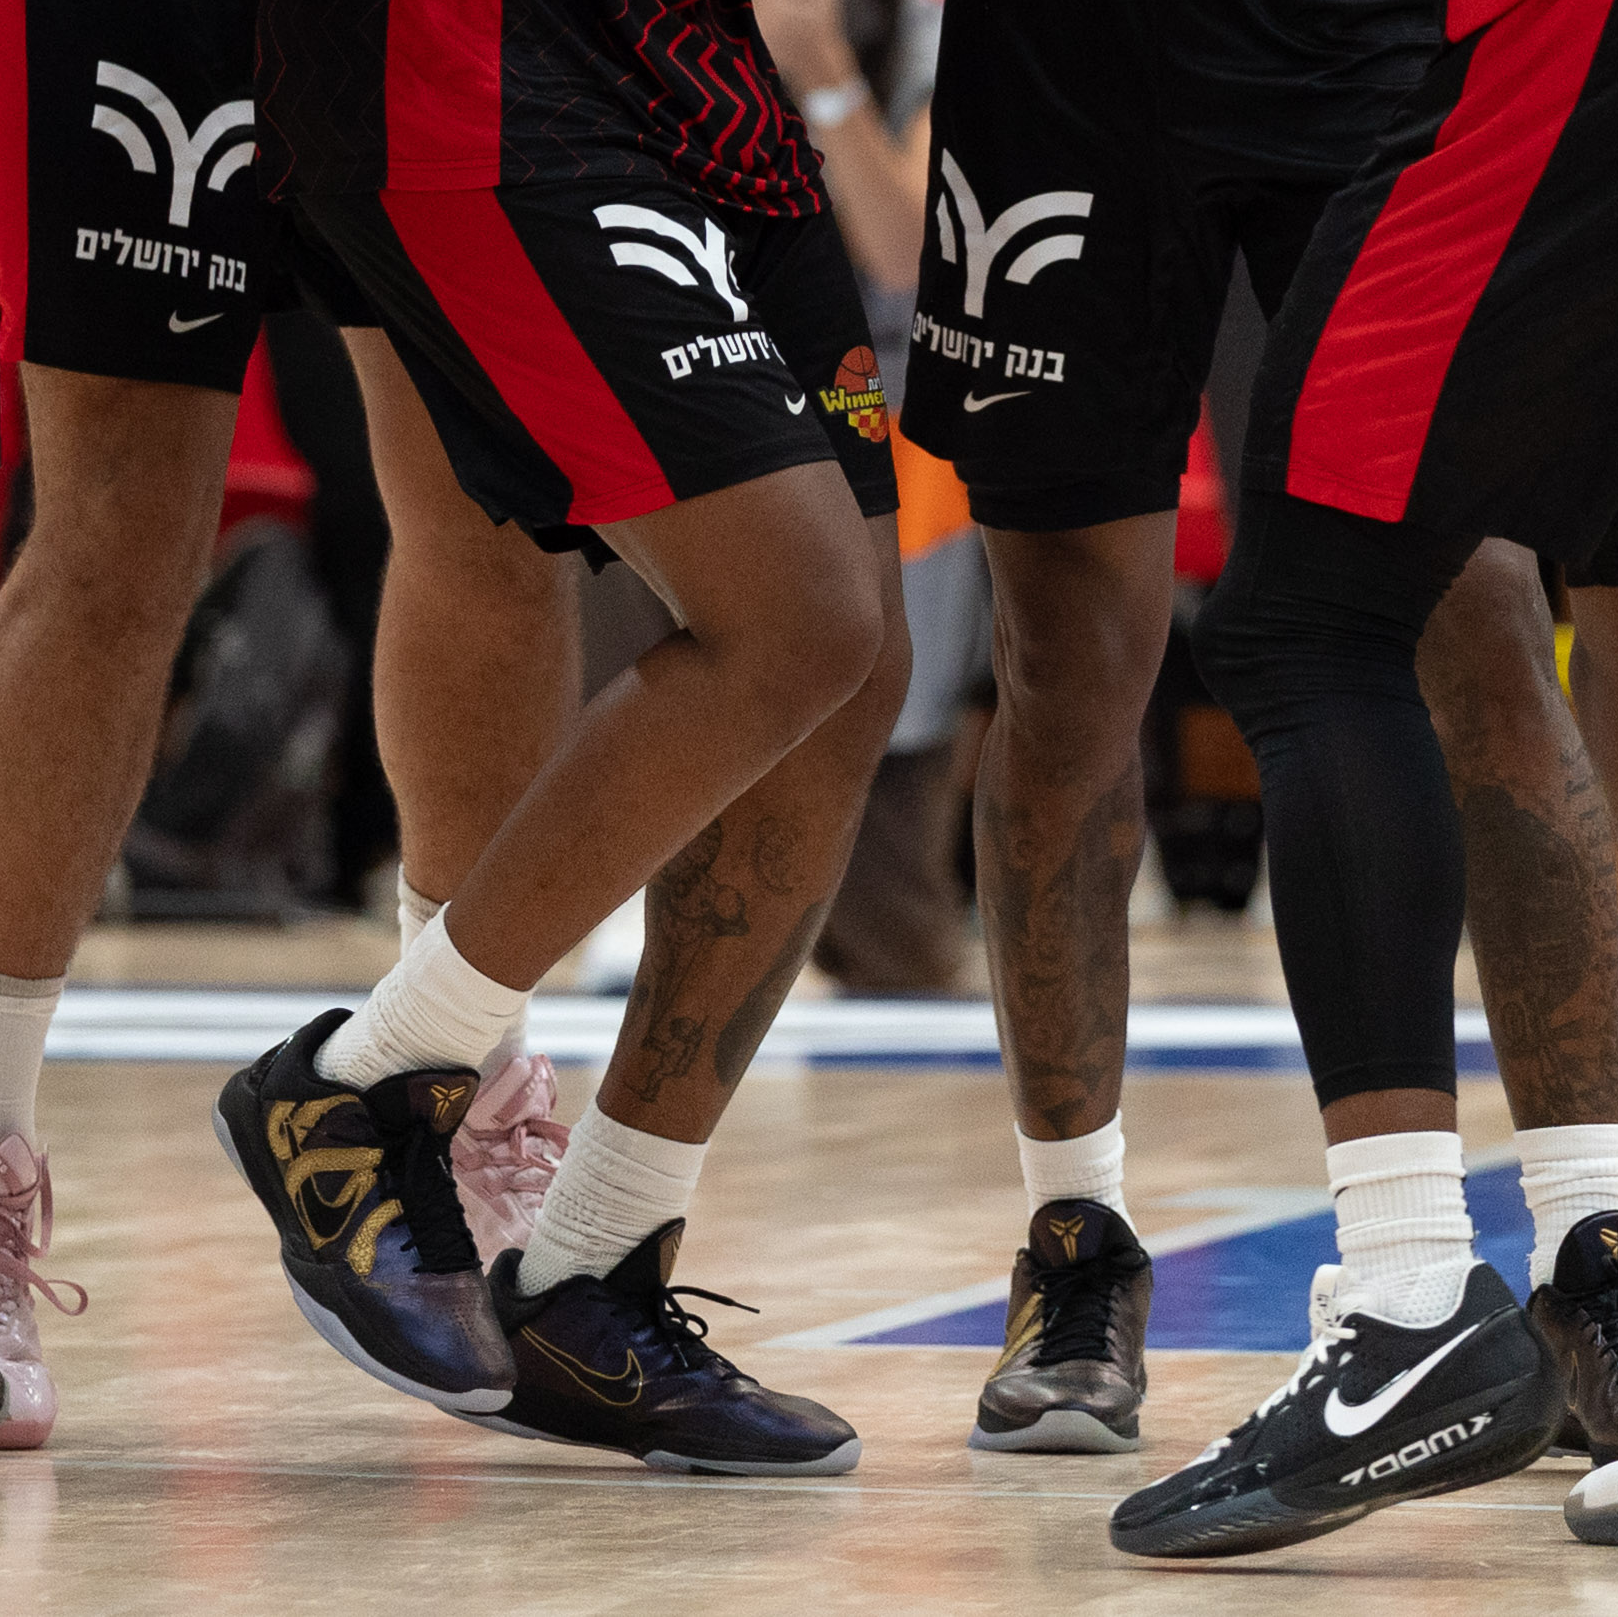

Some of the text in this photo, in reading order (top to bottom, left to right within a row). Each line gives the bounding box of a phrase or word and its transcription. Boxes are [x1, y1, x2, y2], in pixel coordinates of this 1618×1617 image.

[75, 228, 247, 293] בנק ירושלים
[661, 331, 770, 380] ירושלים
[912, 311, 1065, 382] בנק ירושלים
